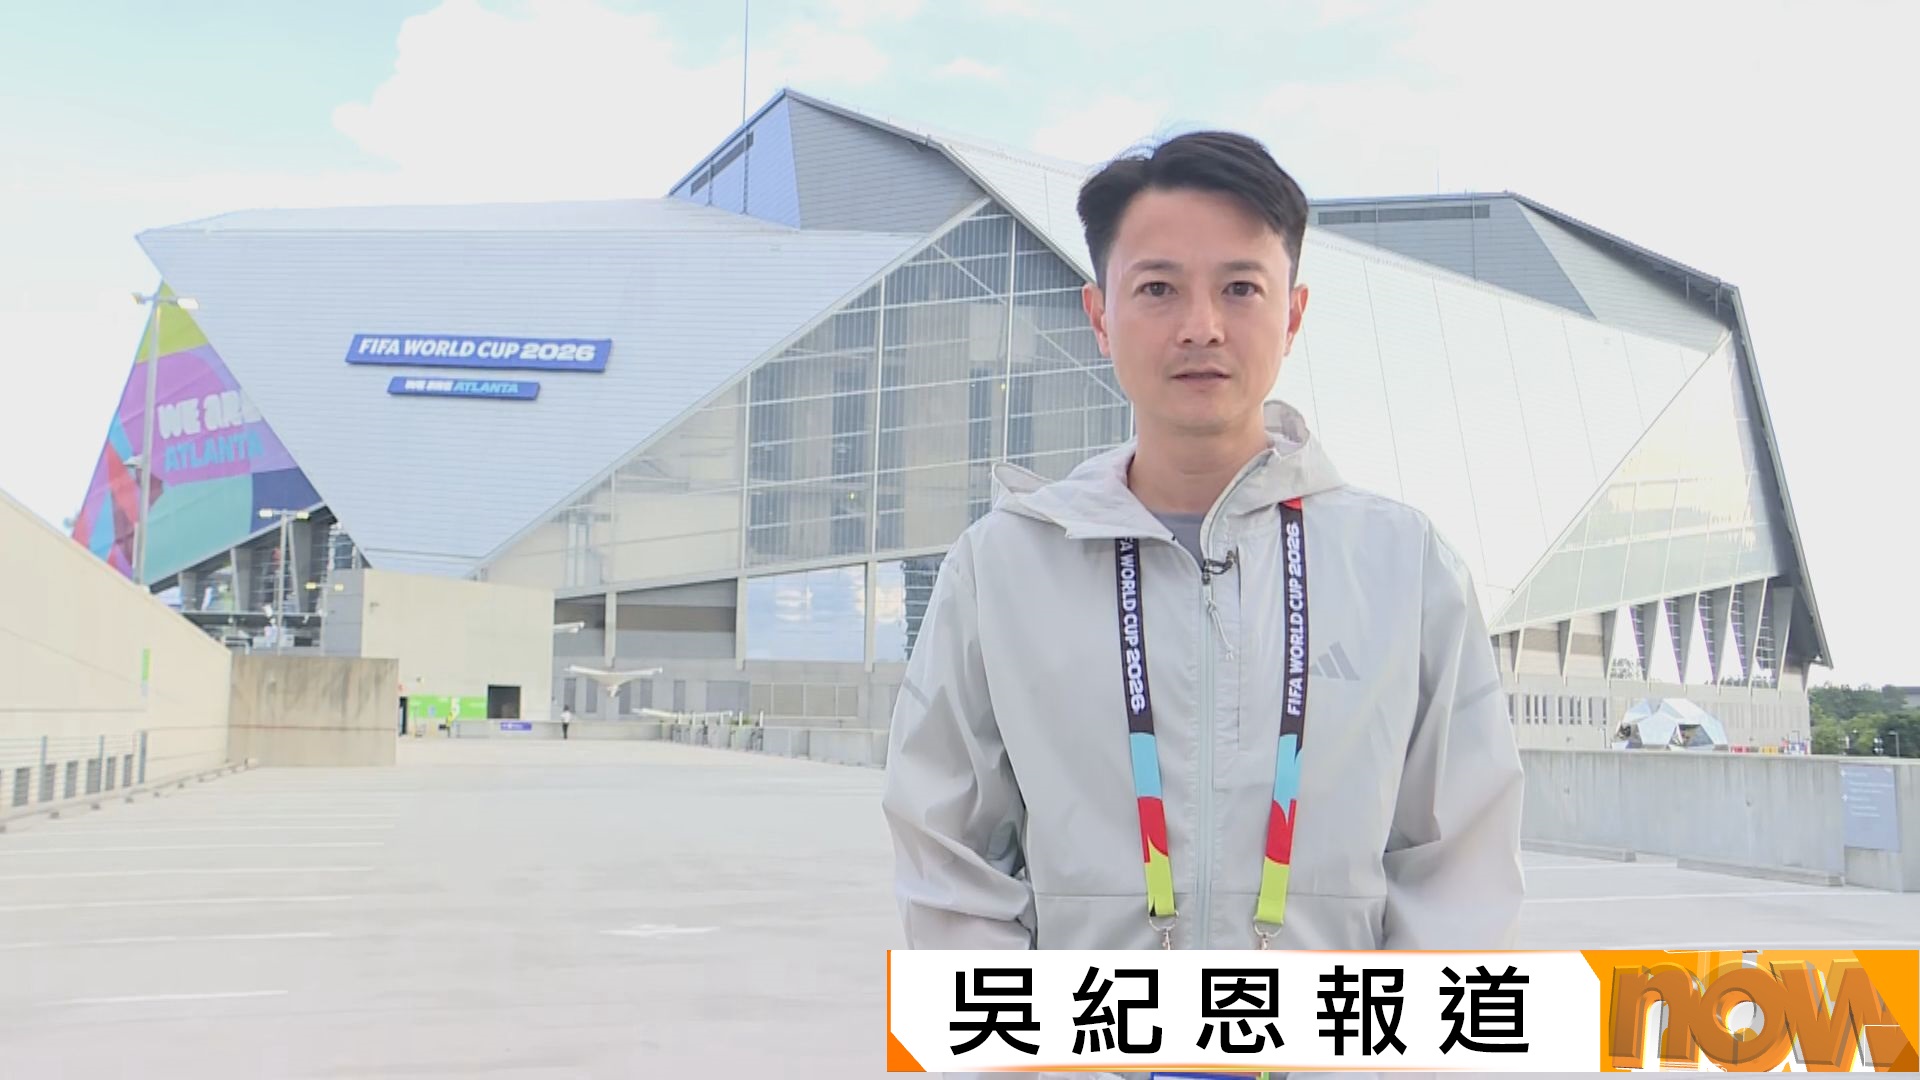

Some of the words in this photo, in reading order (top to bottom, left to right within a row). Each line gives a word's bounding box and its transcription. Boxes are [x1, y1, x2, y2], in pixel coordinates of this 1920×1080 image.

[359, 338, 400, 356] FIFA
[404, 339, 475, 357] WORLD
[478, 342, 520, 359] CUP
[519, 343, 597, 362] 2026
[453, 380, 519, 394] ATLANTA
[157, 398, 201, 440] WE
[163, 430, 264, 473] ATLANTA
[1286, 522, 1302, 577] 2026
[1120, 553, 1137, 612] WORLD
[1289, 577, 1303, 613] CUP
[1123, 613, 1140, 647] CUP
[1289, 614, 1304, 674] WORLD
[1126, 647, 1146, 715] 2026
[1287, 678, 1301, 716] FIFA
